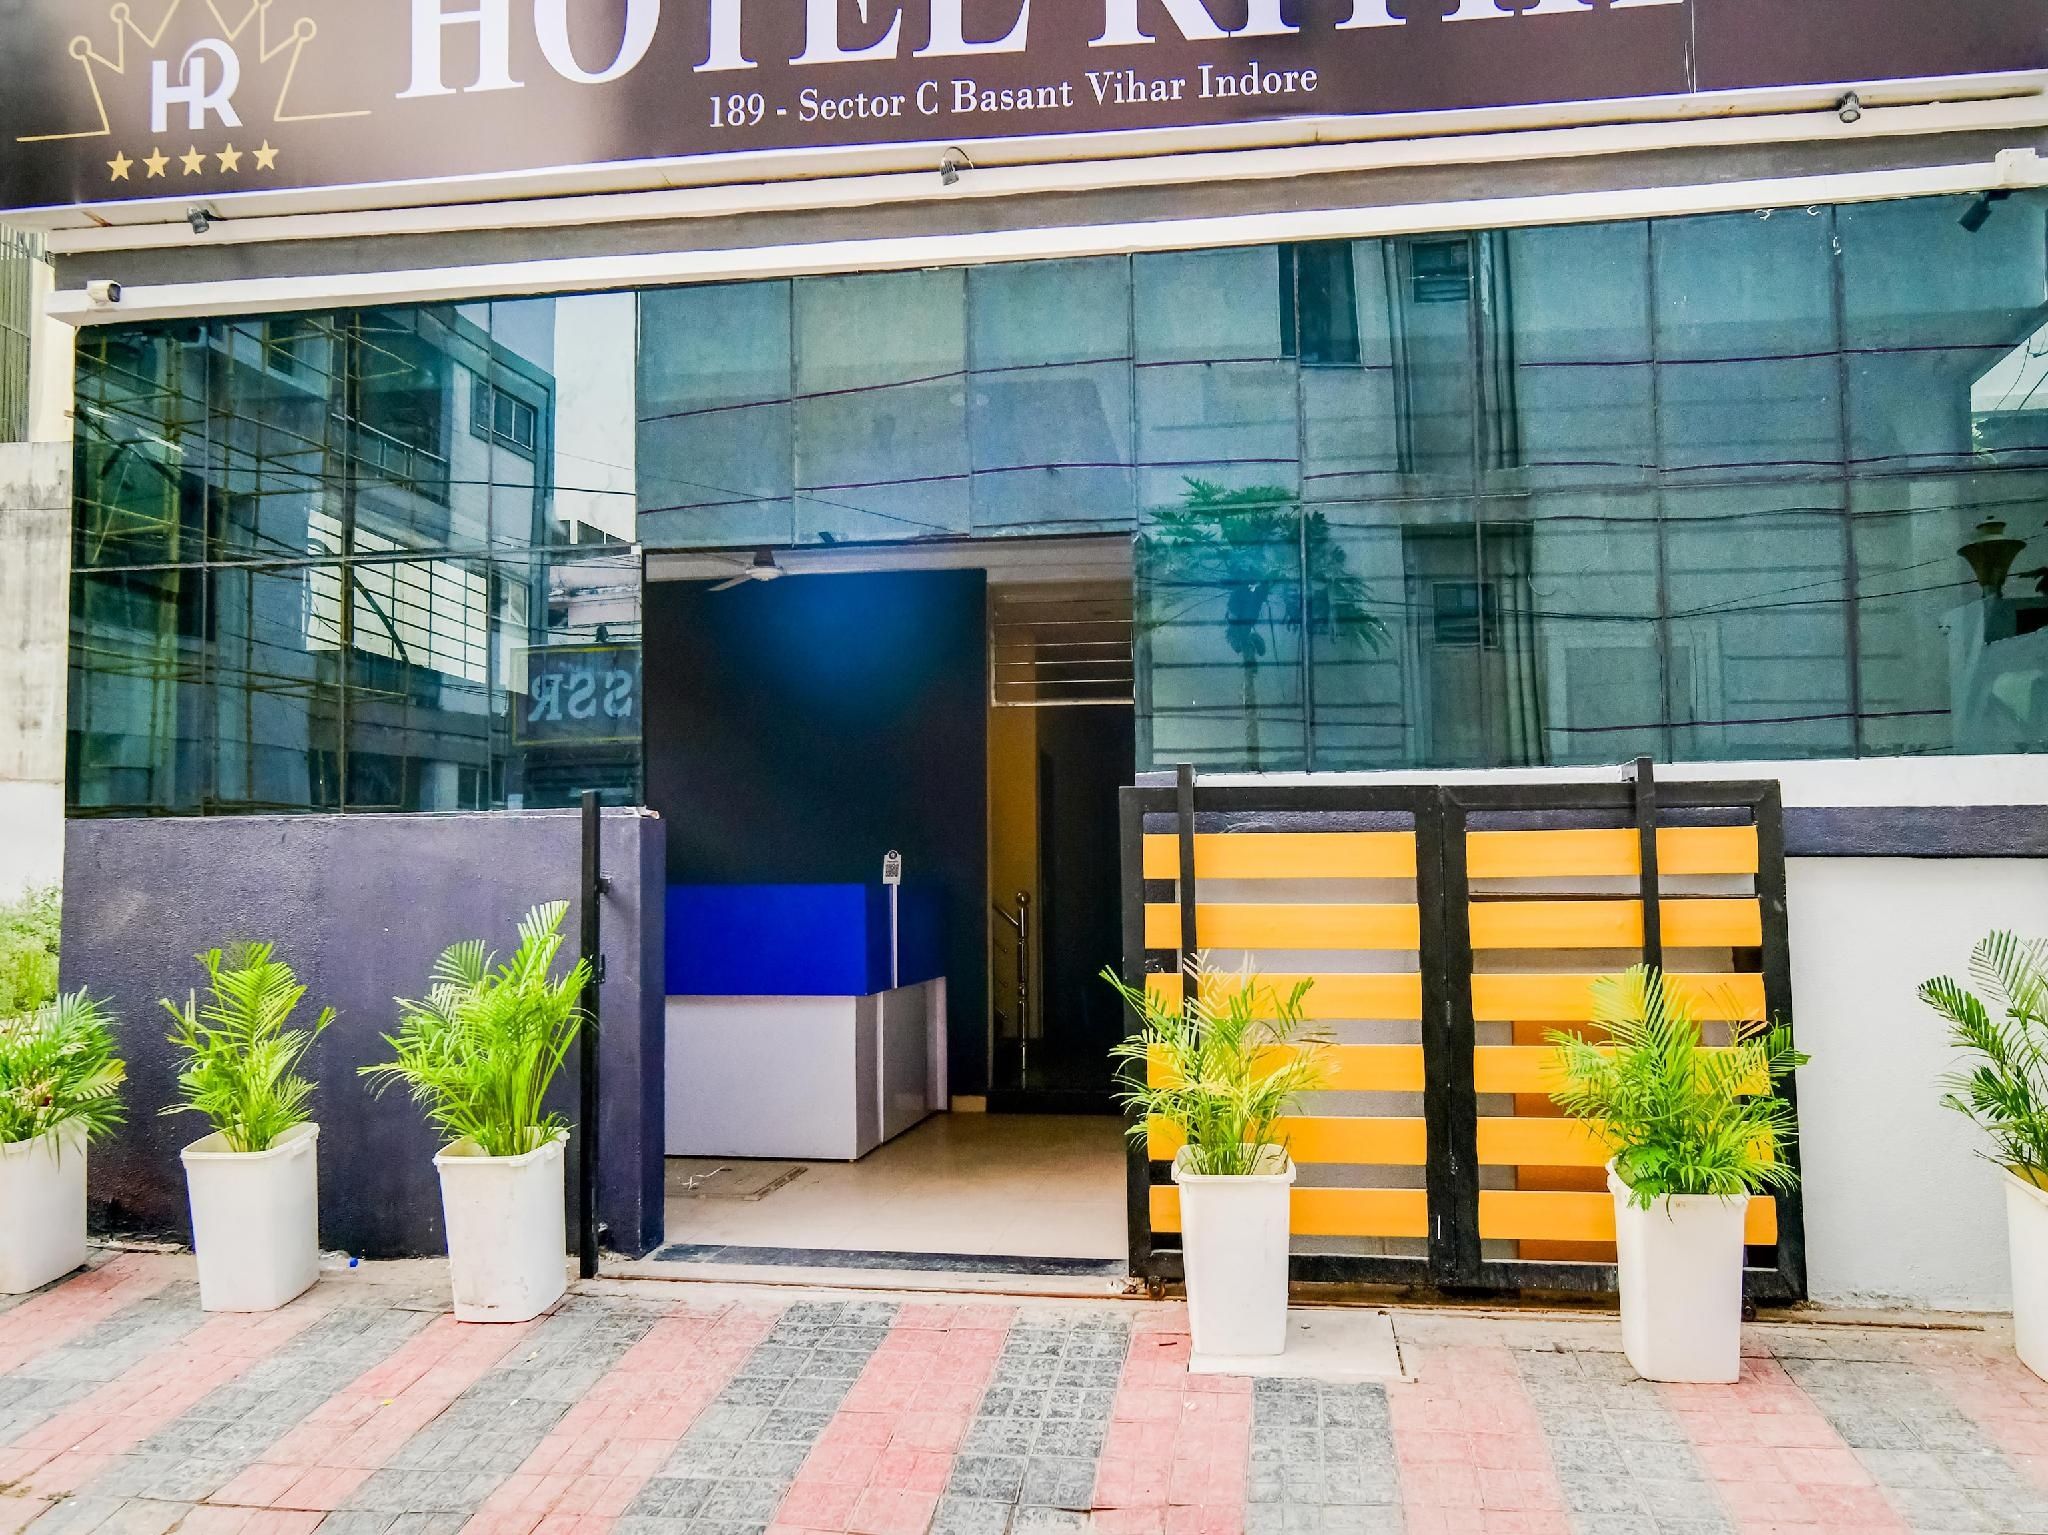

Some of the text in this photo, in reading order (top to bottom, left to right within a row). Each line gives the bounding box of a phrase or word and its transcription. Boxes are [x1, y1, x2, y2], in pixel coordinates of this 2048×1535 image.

[709, 93, 765, 128] 189
[799, 88, 906, 122] Sector
[916, 80, 939, 115] C
[950, 79, 1074, 114] Basant
[1084, 69, 1187, 106] Vihar
[1197, 61, 1319, 99] Indore
